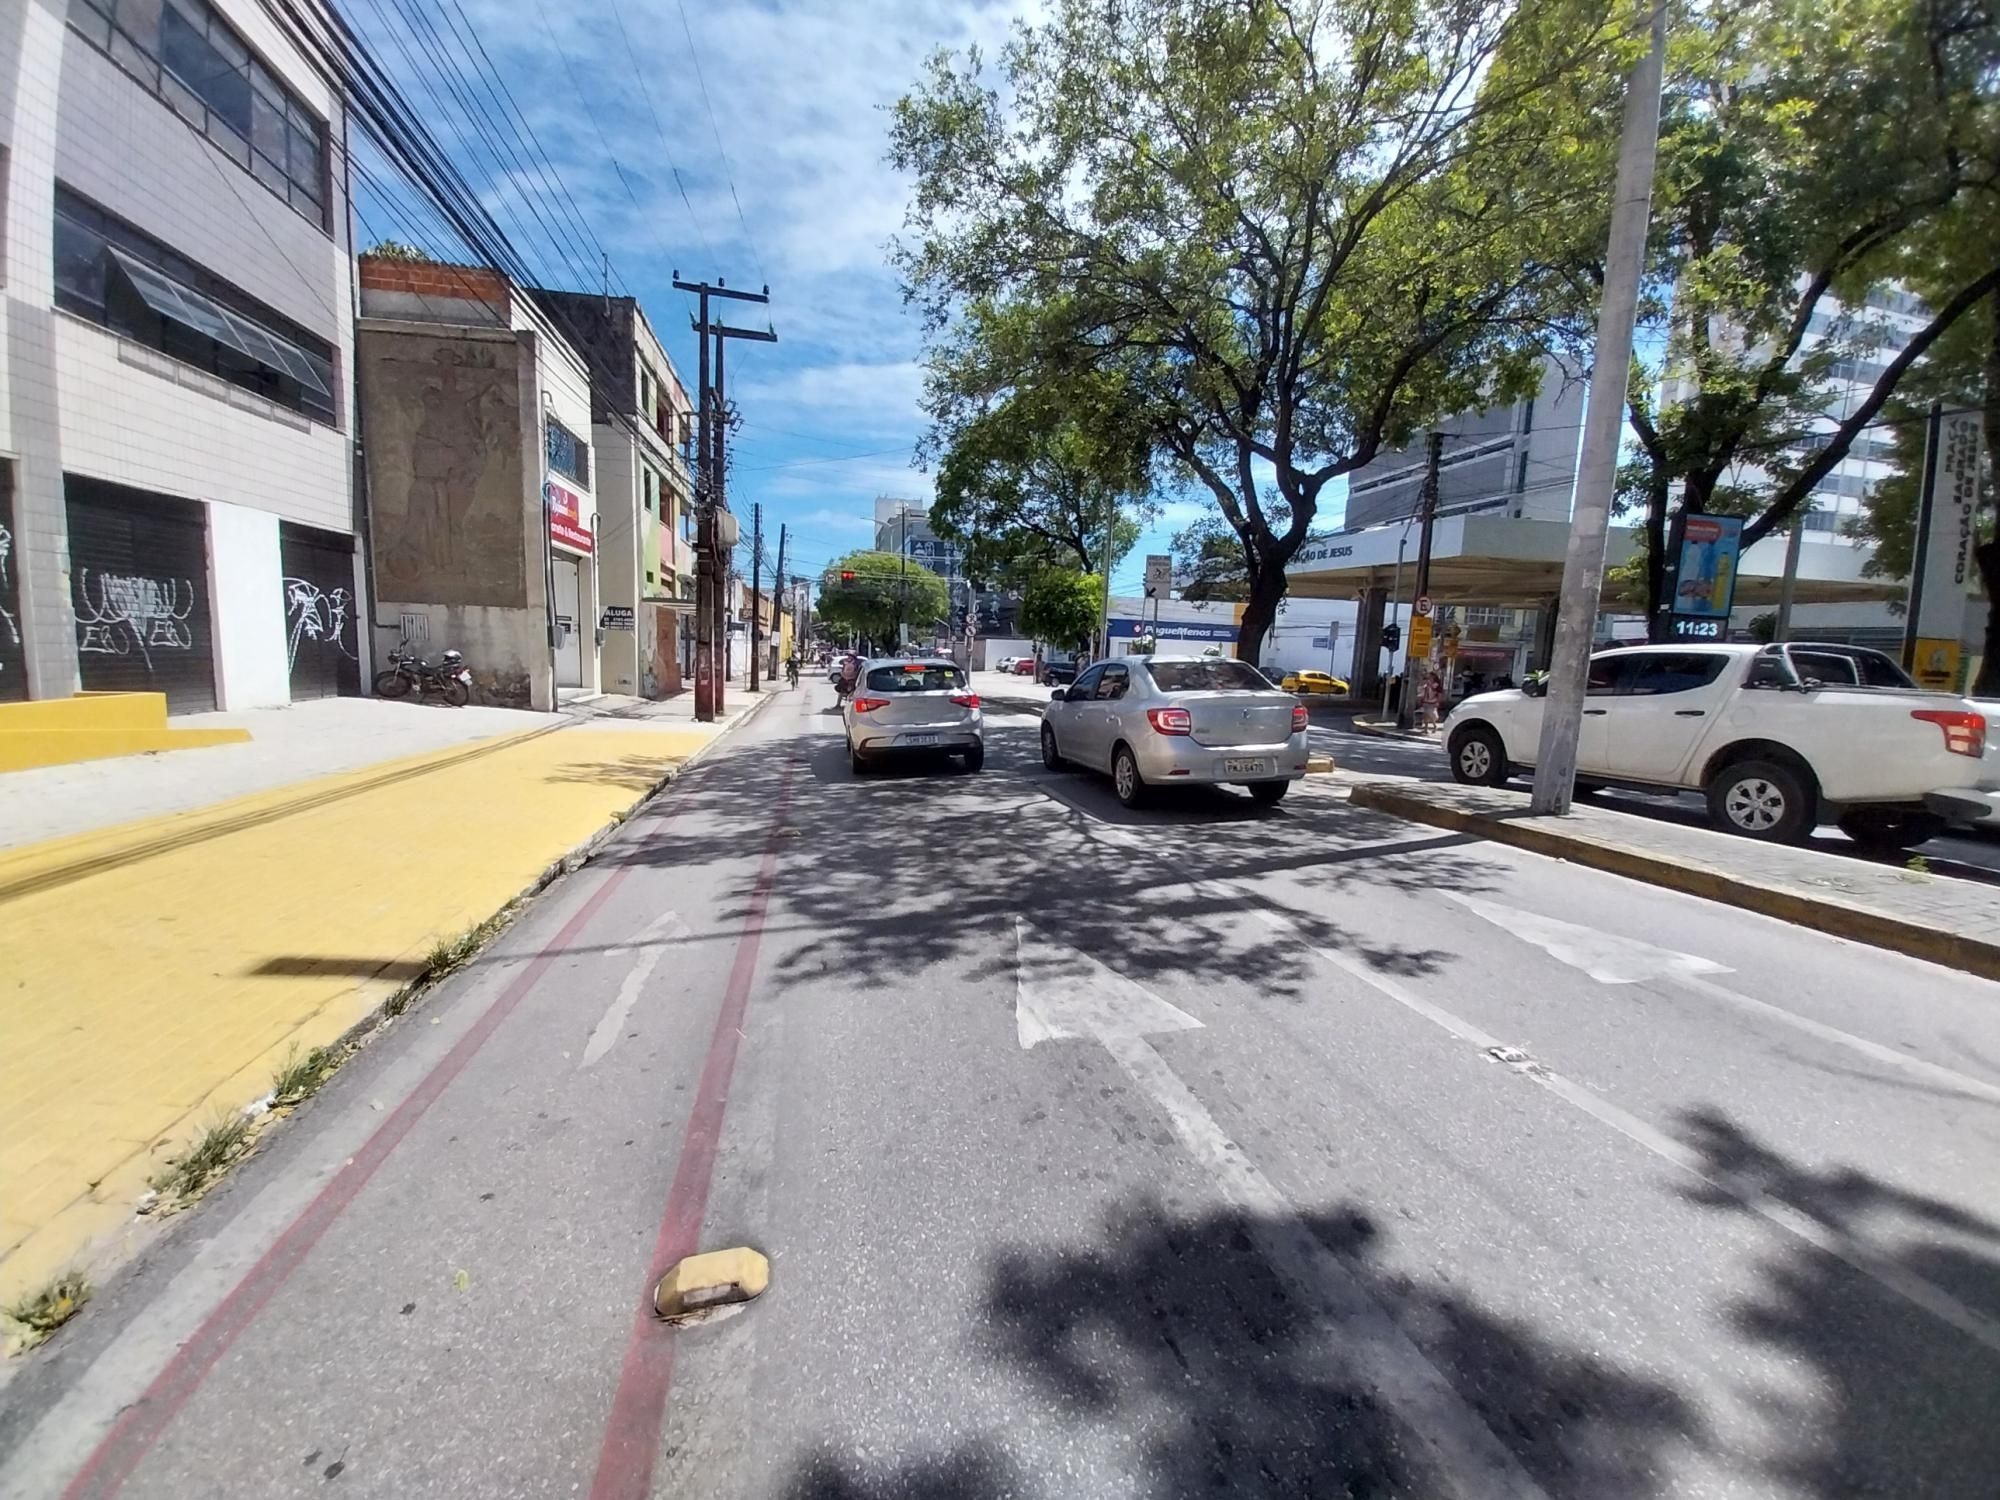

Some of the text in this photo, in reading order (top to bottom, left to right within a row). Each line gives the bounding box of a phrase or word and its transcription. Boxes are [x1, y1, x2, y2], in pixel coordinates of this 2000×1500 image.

[1945, 418, 1959, 473] PRAÇA
[1953, 420, 1969, 504] SAGRADO
[1955, 422, 1978, 584] CORAÇÃO DE JESUS
[1317, 548, 1328, 560] DE
[1329, 546, 1353, 558] JESUS
[1677, 621, 1718, 636] 11:23
